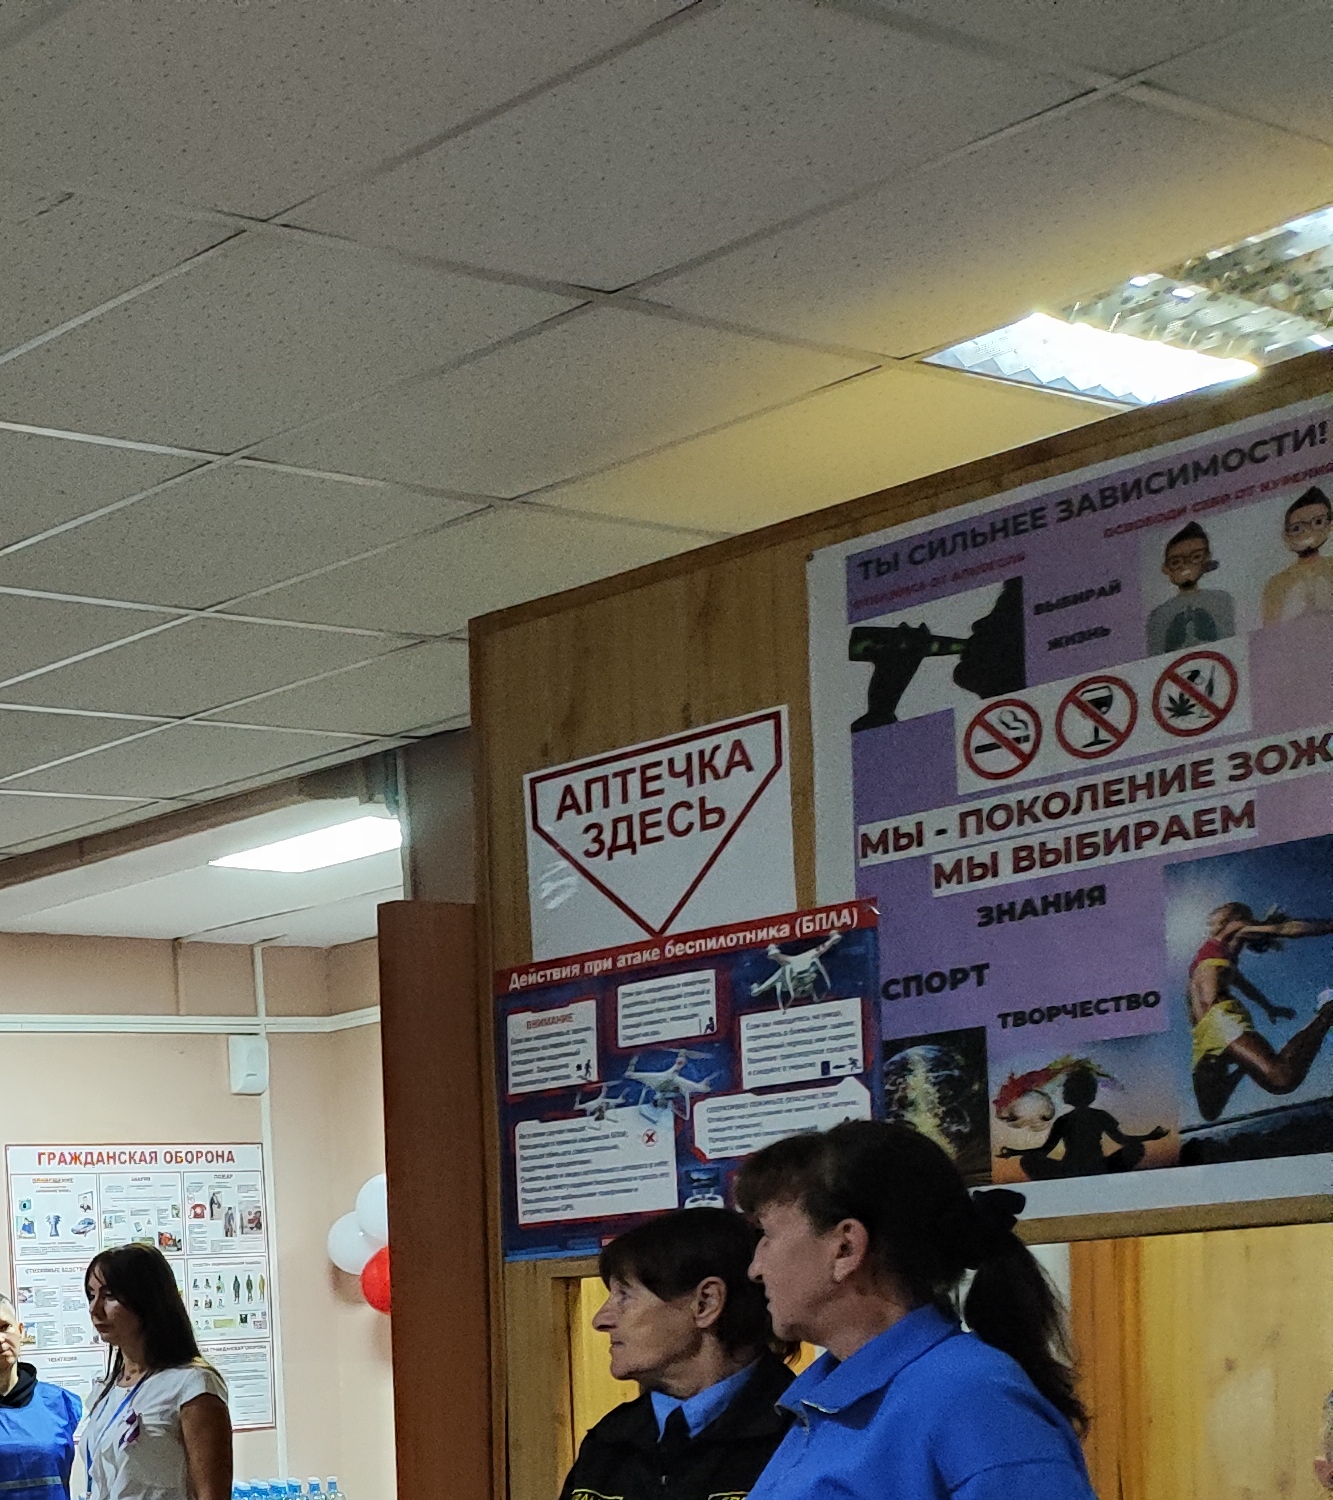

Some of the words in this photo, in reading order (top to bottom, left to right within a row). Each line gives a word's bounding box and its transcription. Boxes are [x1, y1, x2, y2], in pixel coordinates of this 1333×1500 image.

[857, 552, 900, 581] ТЫ
[908, 505, 1048, 566] СИЛЬНЕЕ
[1055, 420, 1328, 523] ЗАВИСИМОСТИ!
[555, 738, 754, 822] АПТЕЧКА
[860, 822, 924, 859] МЫ
[959, 757, 1215, 839] ПОКОЛЕНИЕ
[1228, 732, 1333, 782] ЗОЖ
[582, 795, 726, 861] ЗДЕСЬ
[934, 851, 999, 889] МЫ
[1013, 800, 1256, 875] ВЫБИРАЕМ
[977, 884, 1106, 928] ЗНАНИЯ
[508, 961, 581, 992] Действия
[583, 957, 613, 978] при
[616, 948, 661, 969] атаке
[664, 922, 791, 960] беспилотника
[794, 906, 858, 938] (БПЛА)
[881, 963, 990, 1002] СПОРТ
[997, 990, 1161, 1029] ТВОРЧЕСТВО
[37, 1150, 158, 1168] ГРАЖДАНСКАЯ
[163, 1149, 235, 1164] ОБОРОНА
